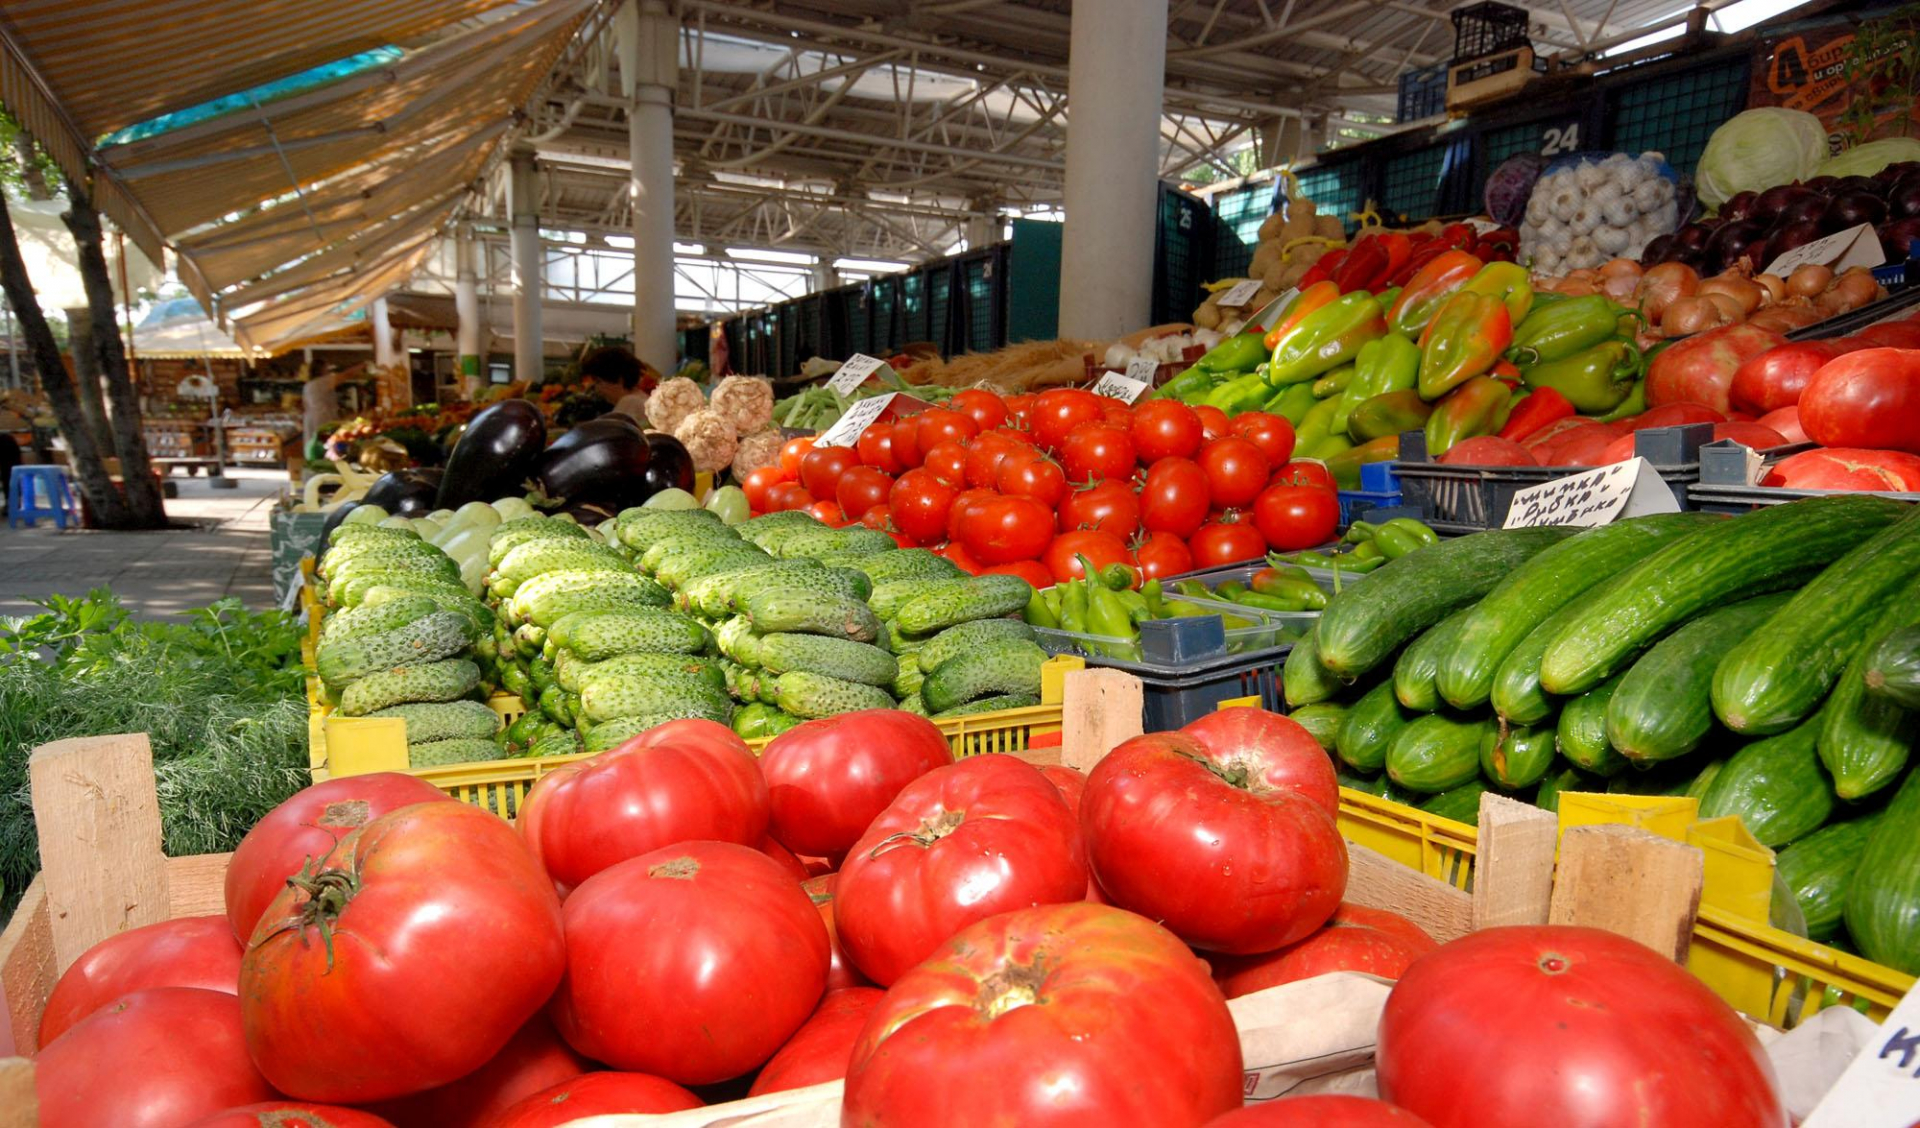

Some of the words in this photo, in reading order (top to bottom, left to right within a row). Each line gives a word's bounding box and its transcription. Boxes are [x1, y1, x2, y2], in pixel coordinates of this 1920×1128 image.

[1777, 47, 1808, 88] 4
[1541, 122, 1579, 156] 24
[1179, 206, 1193, 230] 25
